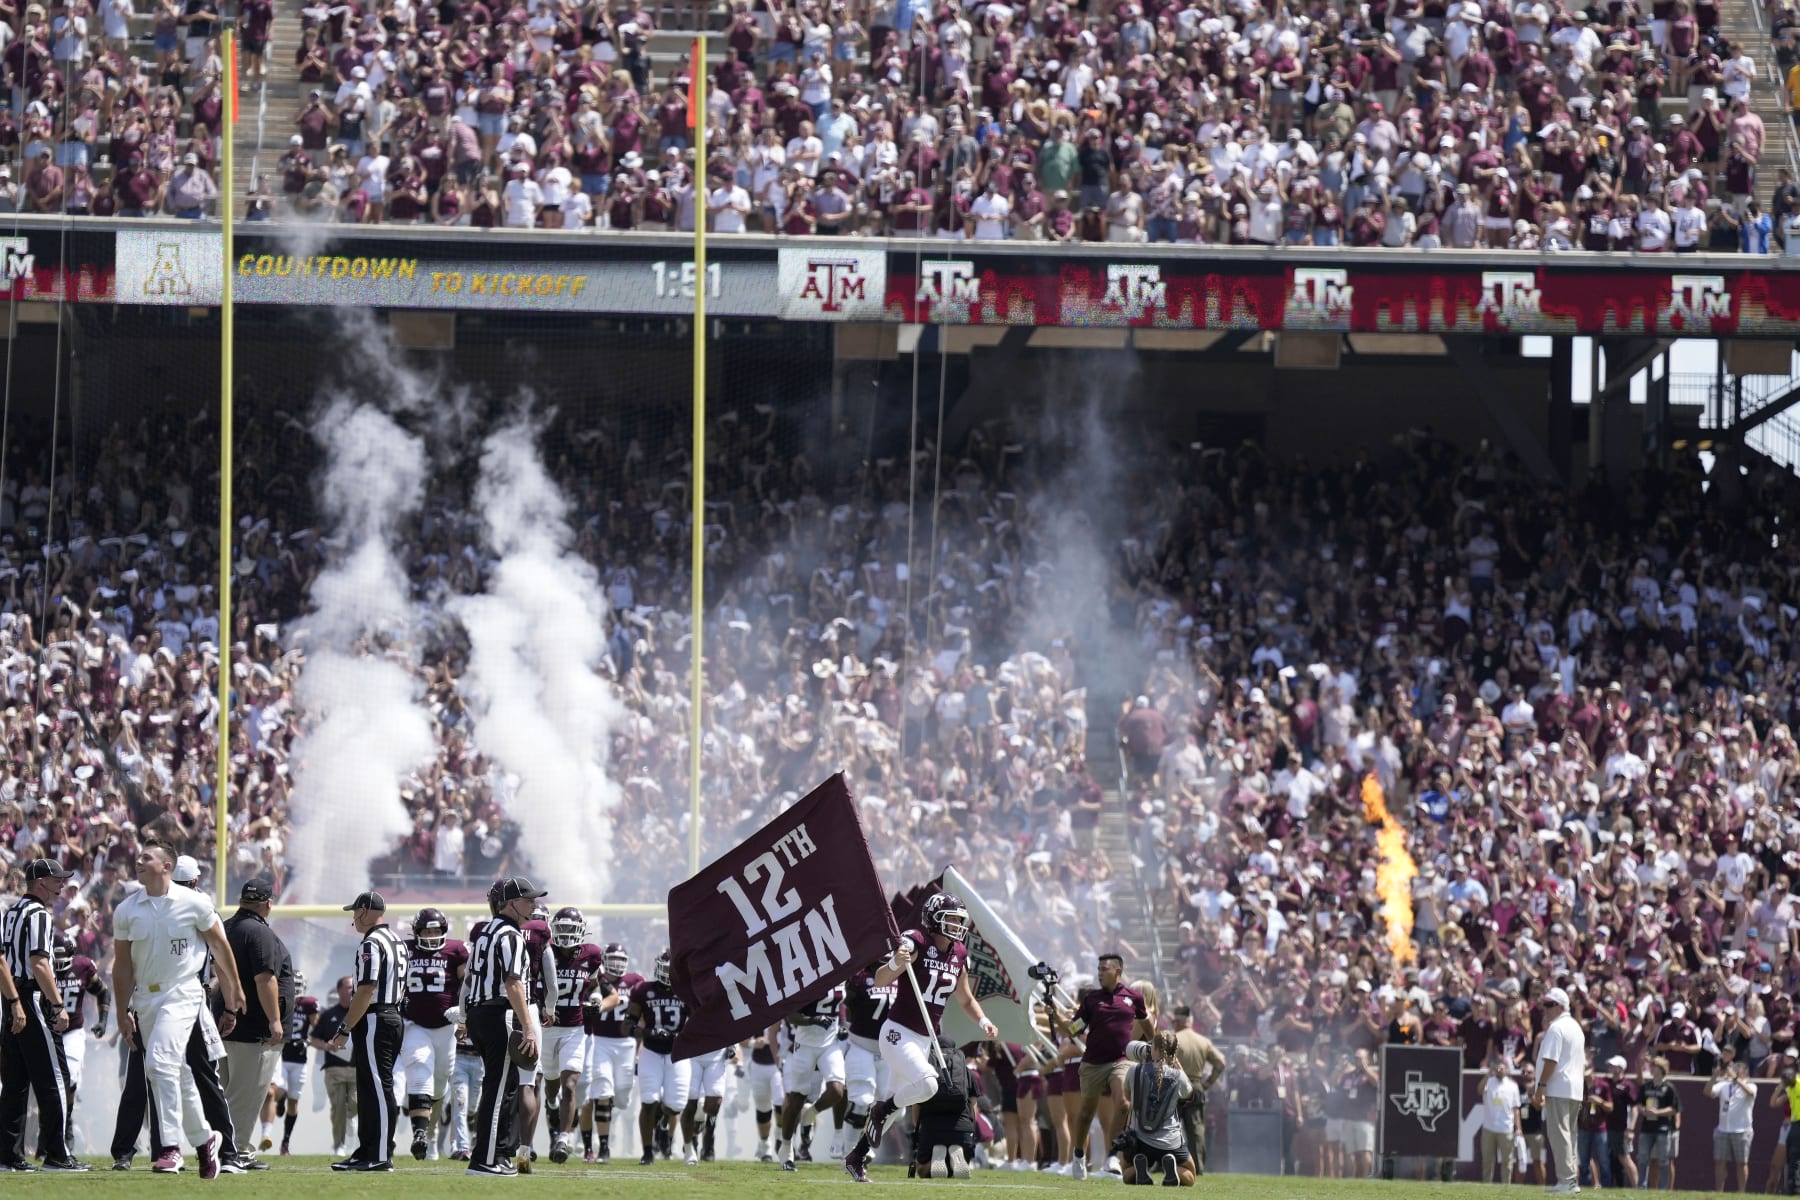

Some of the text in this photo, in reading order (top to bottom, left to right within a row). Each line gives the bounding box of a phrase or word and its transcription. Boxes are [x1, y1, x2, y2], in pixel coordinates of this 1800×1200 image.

[238, 253, 587, 296] COUNTDOWN TO KICKOFF
[652, 261, 721, 297] 1:51
[716, 823, 817, 939] 12TH
[474, 935, 488, 972] C
[715, 894, 851, 1021] MAN
[923, 958, 949, 972] TEXAS
[407, 966, 446, 993] 63
[556, 977, 585, 1007] 21
[922, 969, 958, 1007] 12
[646, 999, 670, 1008] TEXAS
[652, 1006, 681, 1031] 13
